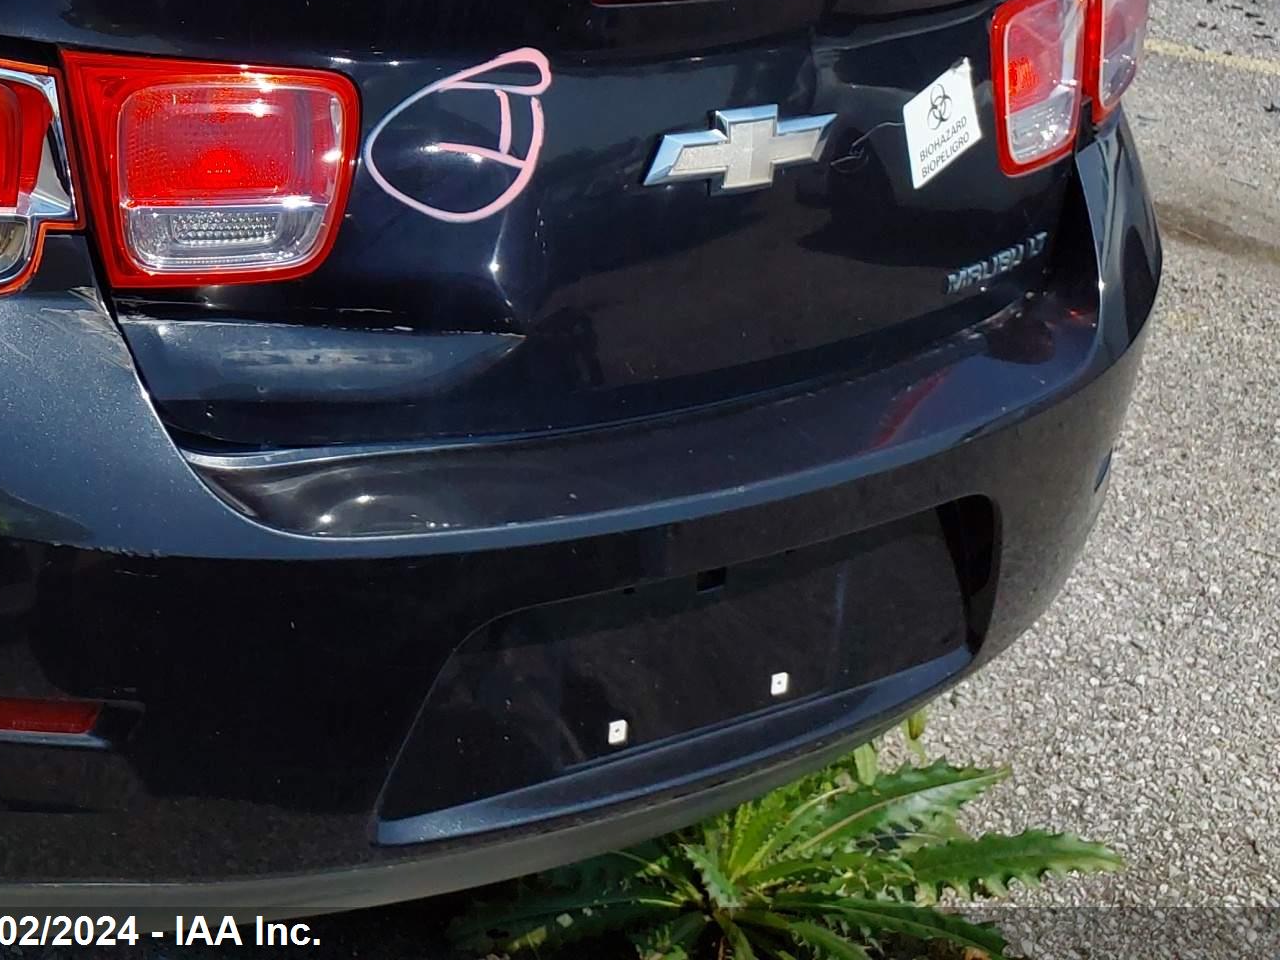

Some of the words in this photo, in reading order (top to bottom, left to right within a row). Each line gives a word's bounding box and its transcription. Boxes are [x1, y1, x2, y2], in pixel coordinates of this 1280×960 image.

[919, 115, 968, 162] BIOHAZARD
[921, 131, 971, 178] BIOPELIGRO
[946, 244, 1024, 293] MALIBU
[1026, 231, 1048, 257] LT
